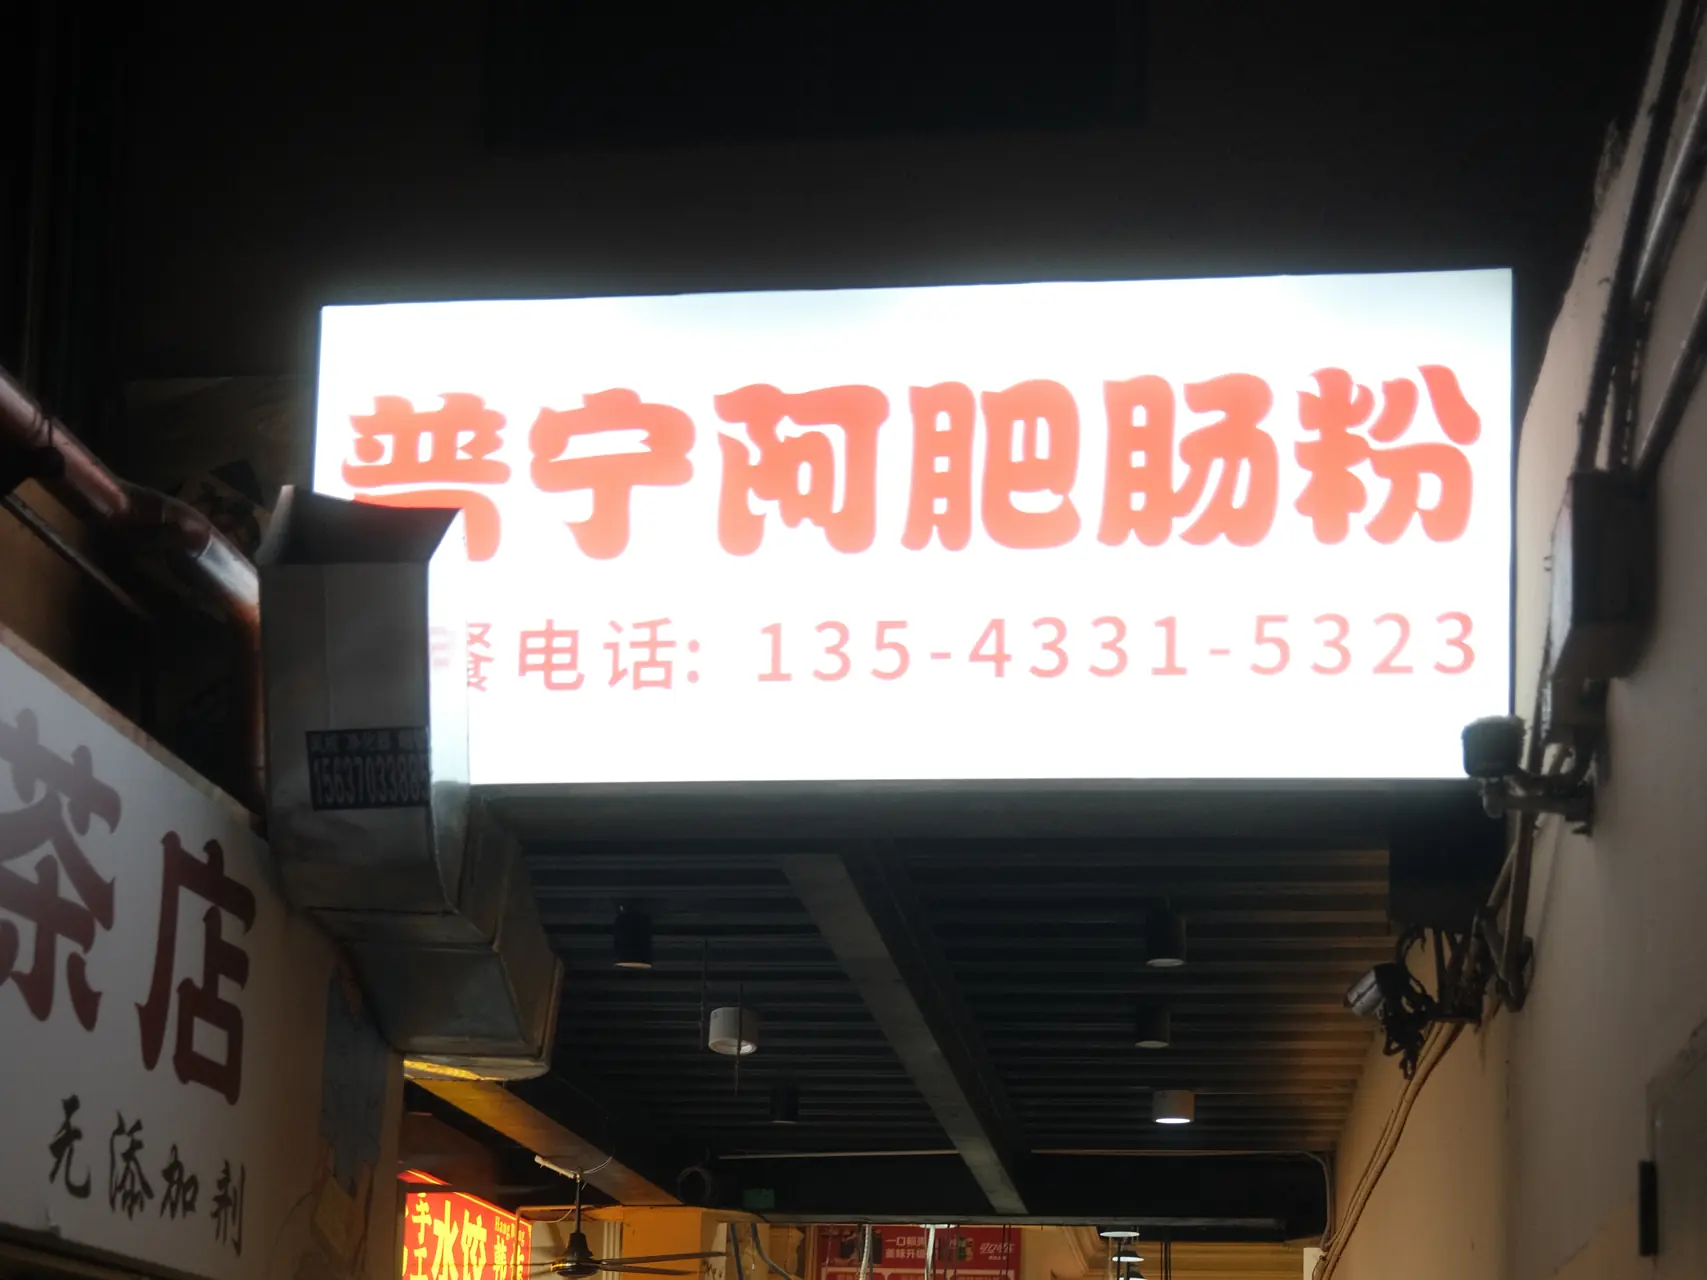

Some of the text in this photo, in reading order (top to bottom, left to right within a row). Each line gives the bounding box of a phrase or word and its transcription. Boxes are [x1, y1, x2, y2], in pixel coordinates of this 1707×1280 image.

[341, 365, 1483, 561] 普宁阿肥肠粉
[757, 611, 1477, 682] 135-4331-5323
[48, 1094, 246, 1257] 无添加剂
